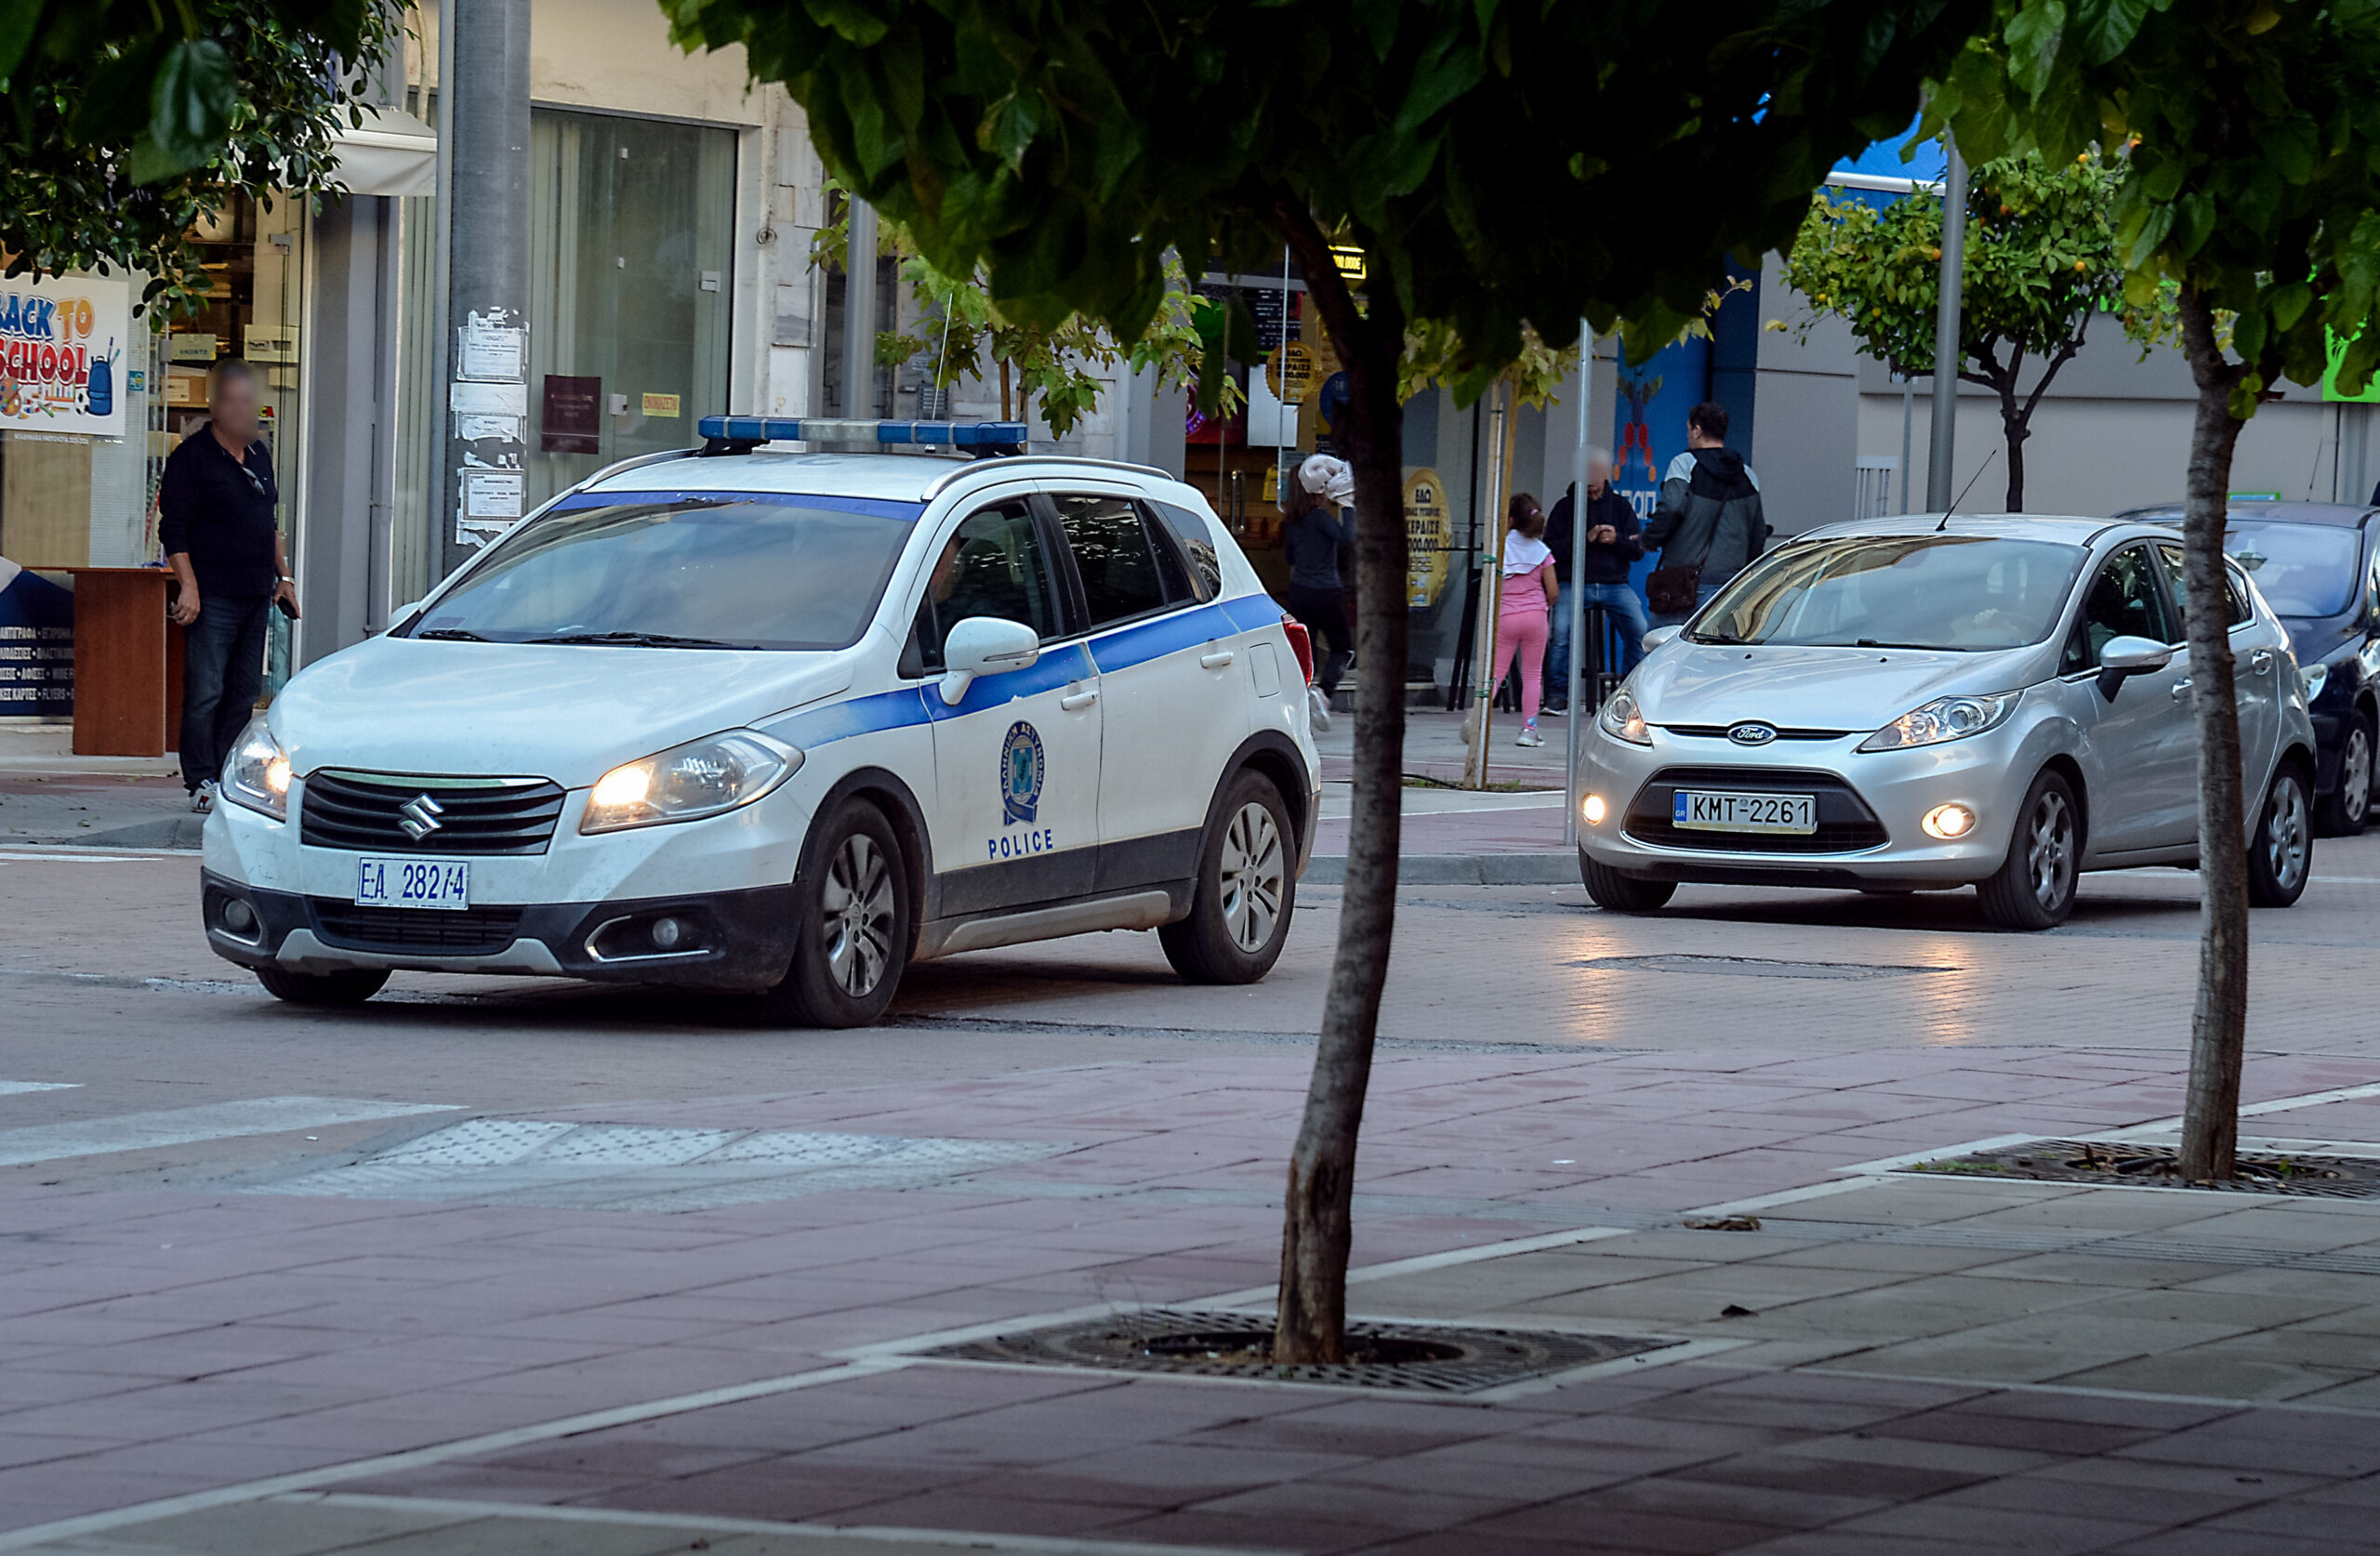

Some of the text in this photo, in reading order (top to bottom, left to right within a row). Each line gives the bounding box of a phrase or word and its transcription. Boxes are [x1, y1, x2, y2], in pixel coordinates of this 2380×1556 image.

[58, 297, 95, 342] TO
[1737, 728, 1764, 740] Ford
[1694, 797, 1808, 824] KMT-2261
[988, 828, 1053, 860] POLICE
